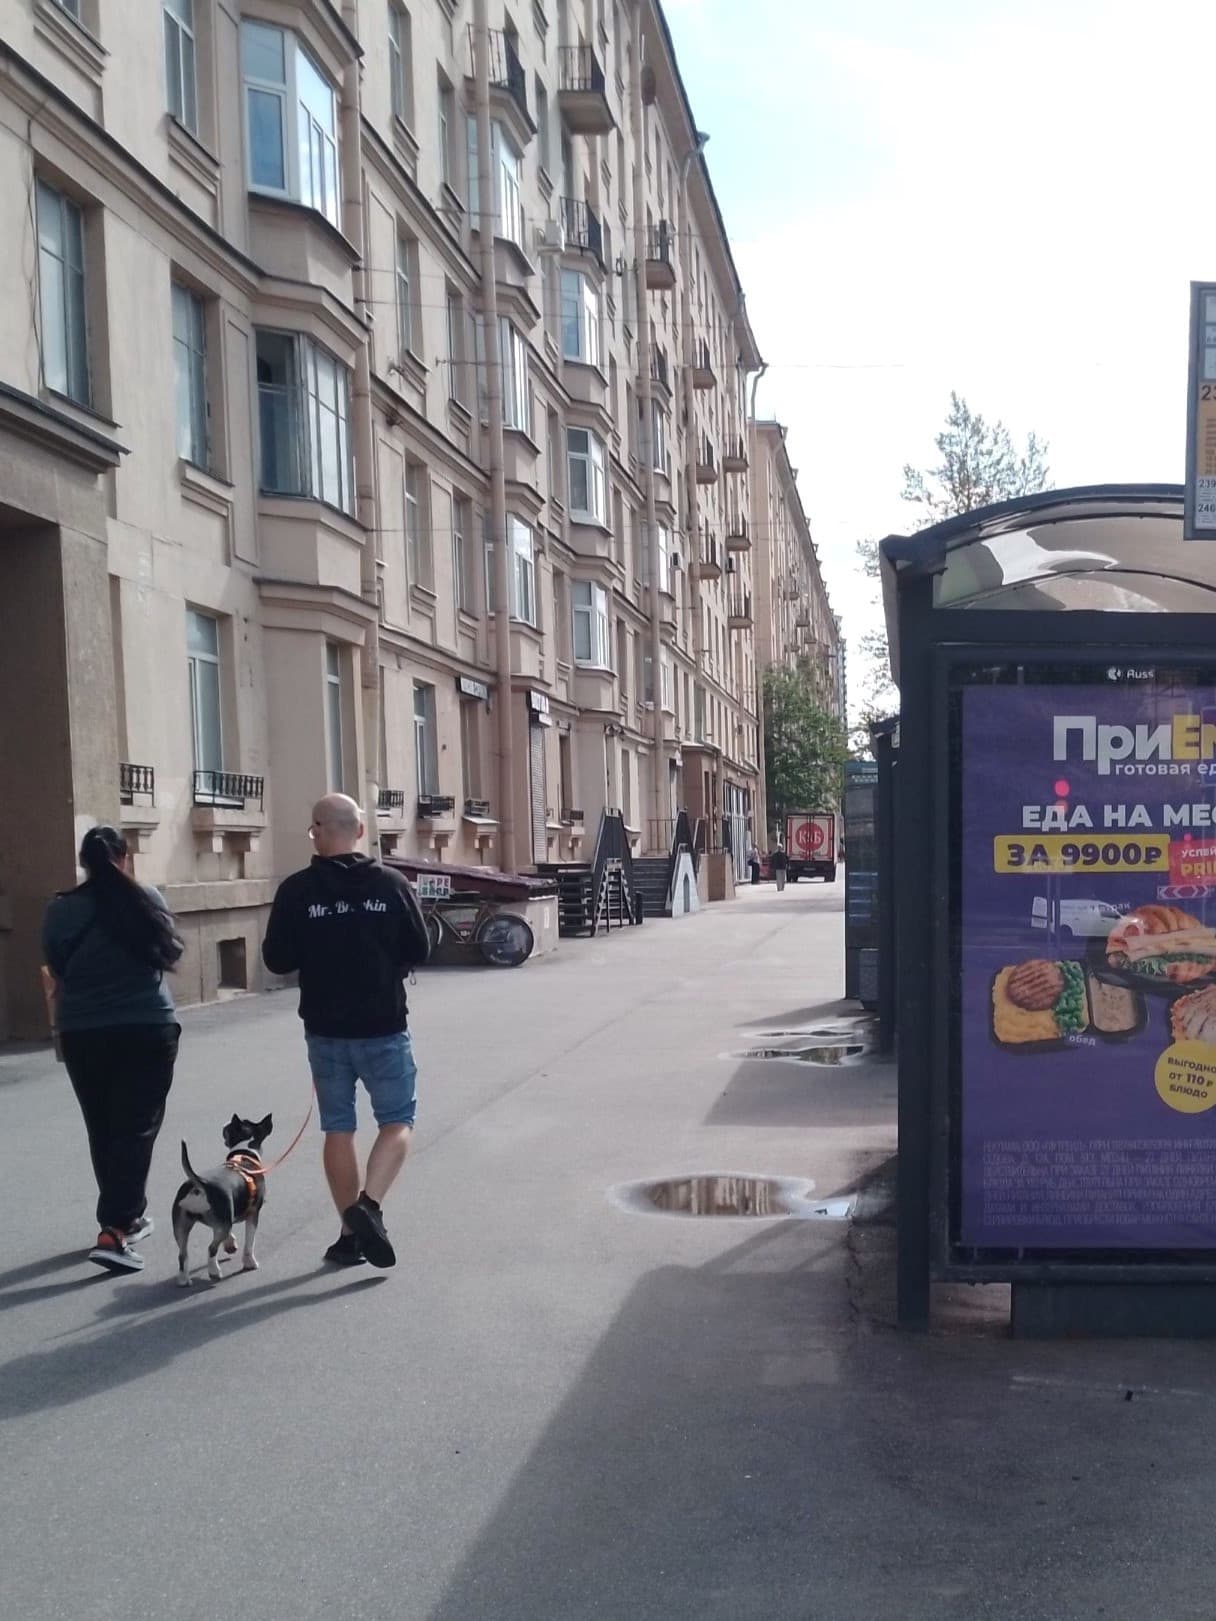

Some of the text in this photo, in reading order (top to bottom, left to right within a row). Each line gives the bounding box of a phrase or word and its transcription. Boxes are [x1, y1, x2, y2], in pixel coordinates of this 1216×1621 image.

[1199, 479, 1216, 489] 239
[1198, 503, 1216, 513] 246
[1126, 669, 1154, 680] Russ
[1116, 763, 1191, 775] готовая
[1022, 804, 1093, 832] ЕДА
[1103, 803, 1153, 828] НА
[1007, 843, 1050, 867] ЗА
[308, 903, 333, 919] Mr.
[1186, 1072, 1205, 1085] 110
